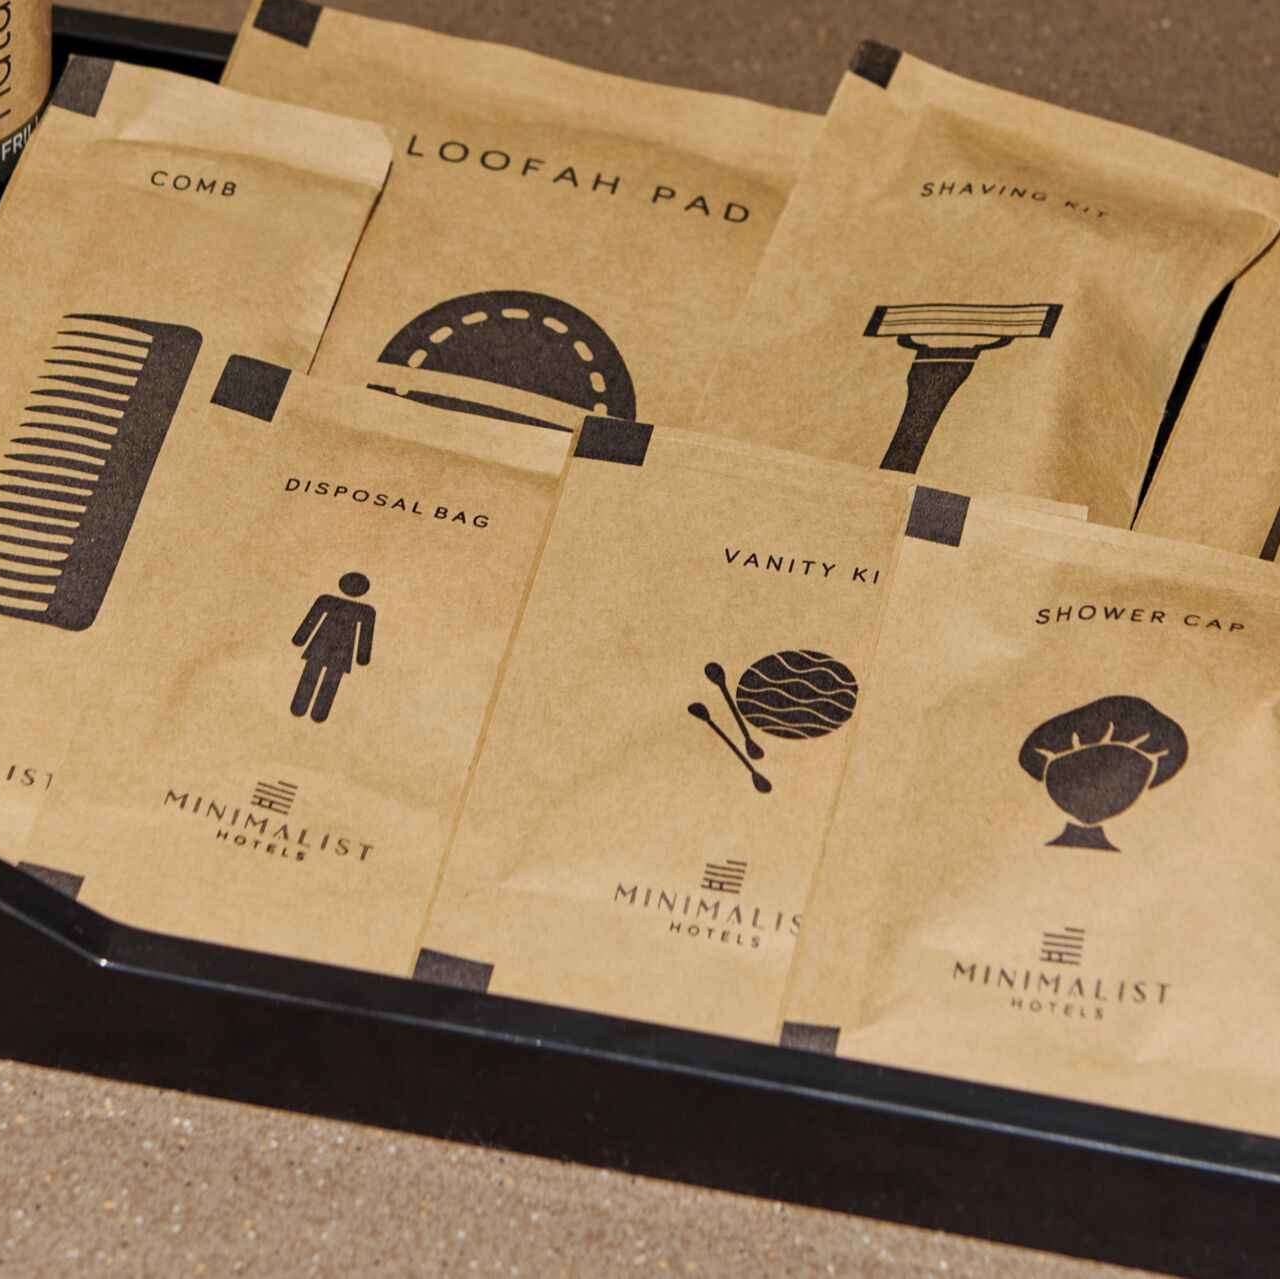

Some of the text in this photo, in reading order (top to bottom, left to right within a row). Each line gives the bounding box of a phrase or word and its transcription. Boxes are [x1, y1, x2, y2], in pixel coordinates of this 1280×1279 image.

[150, 170, 237, 198] COMB
[406, 134, 751, 224] LOOFAH PAD
[921, 182, 1049, 203] SHAVING
[285, 478, 490, 529] DISPOSAL BAG
[725, 547, 880, 584] VANITY KI
[1035, 605, 1245, 632] SHOWER CAP
[164, 789, 375, 862] MINIMALIST
[216, 829, 306, 862] HOTELS
[614, 882, 803, 937] MINIMALIS
[669, 921, 760, 949] HOTELS
[953, 960, 1173, 1006] MINIMALIST
[1010, 996, 1104, 1021] HOTELS
